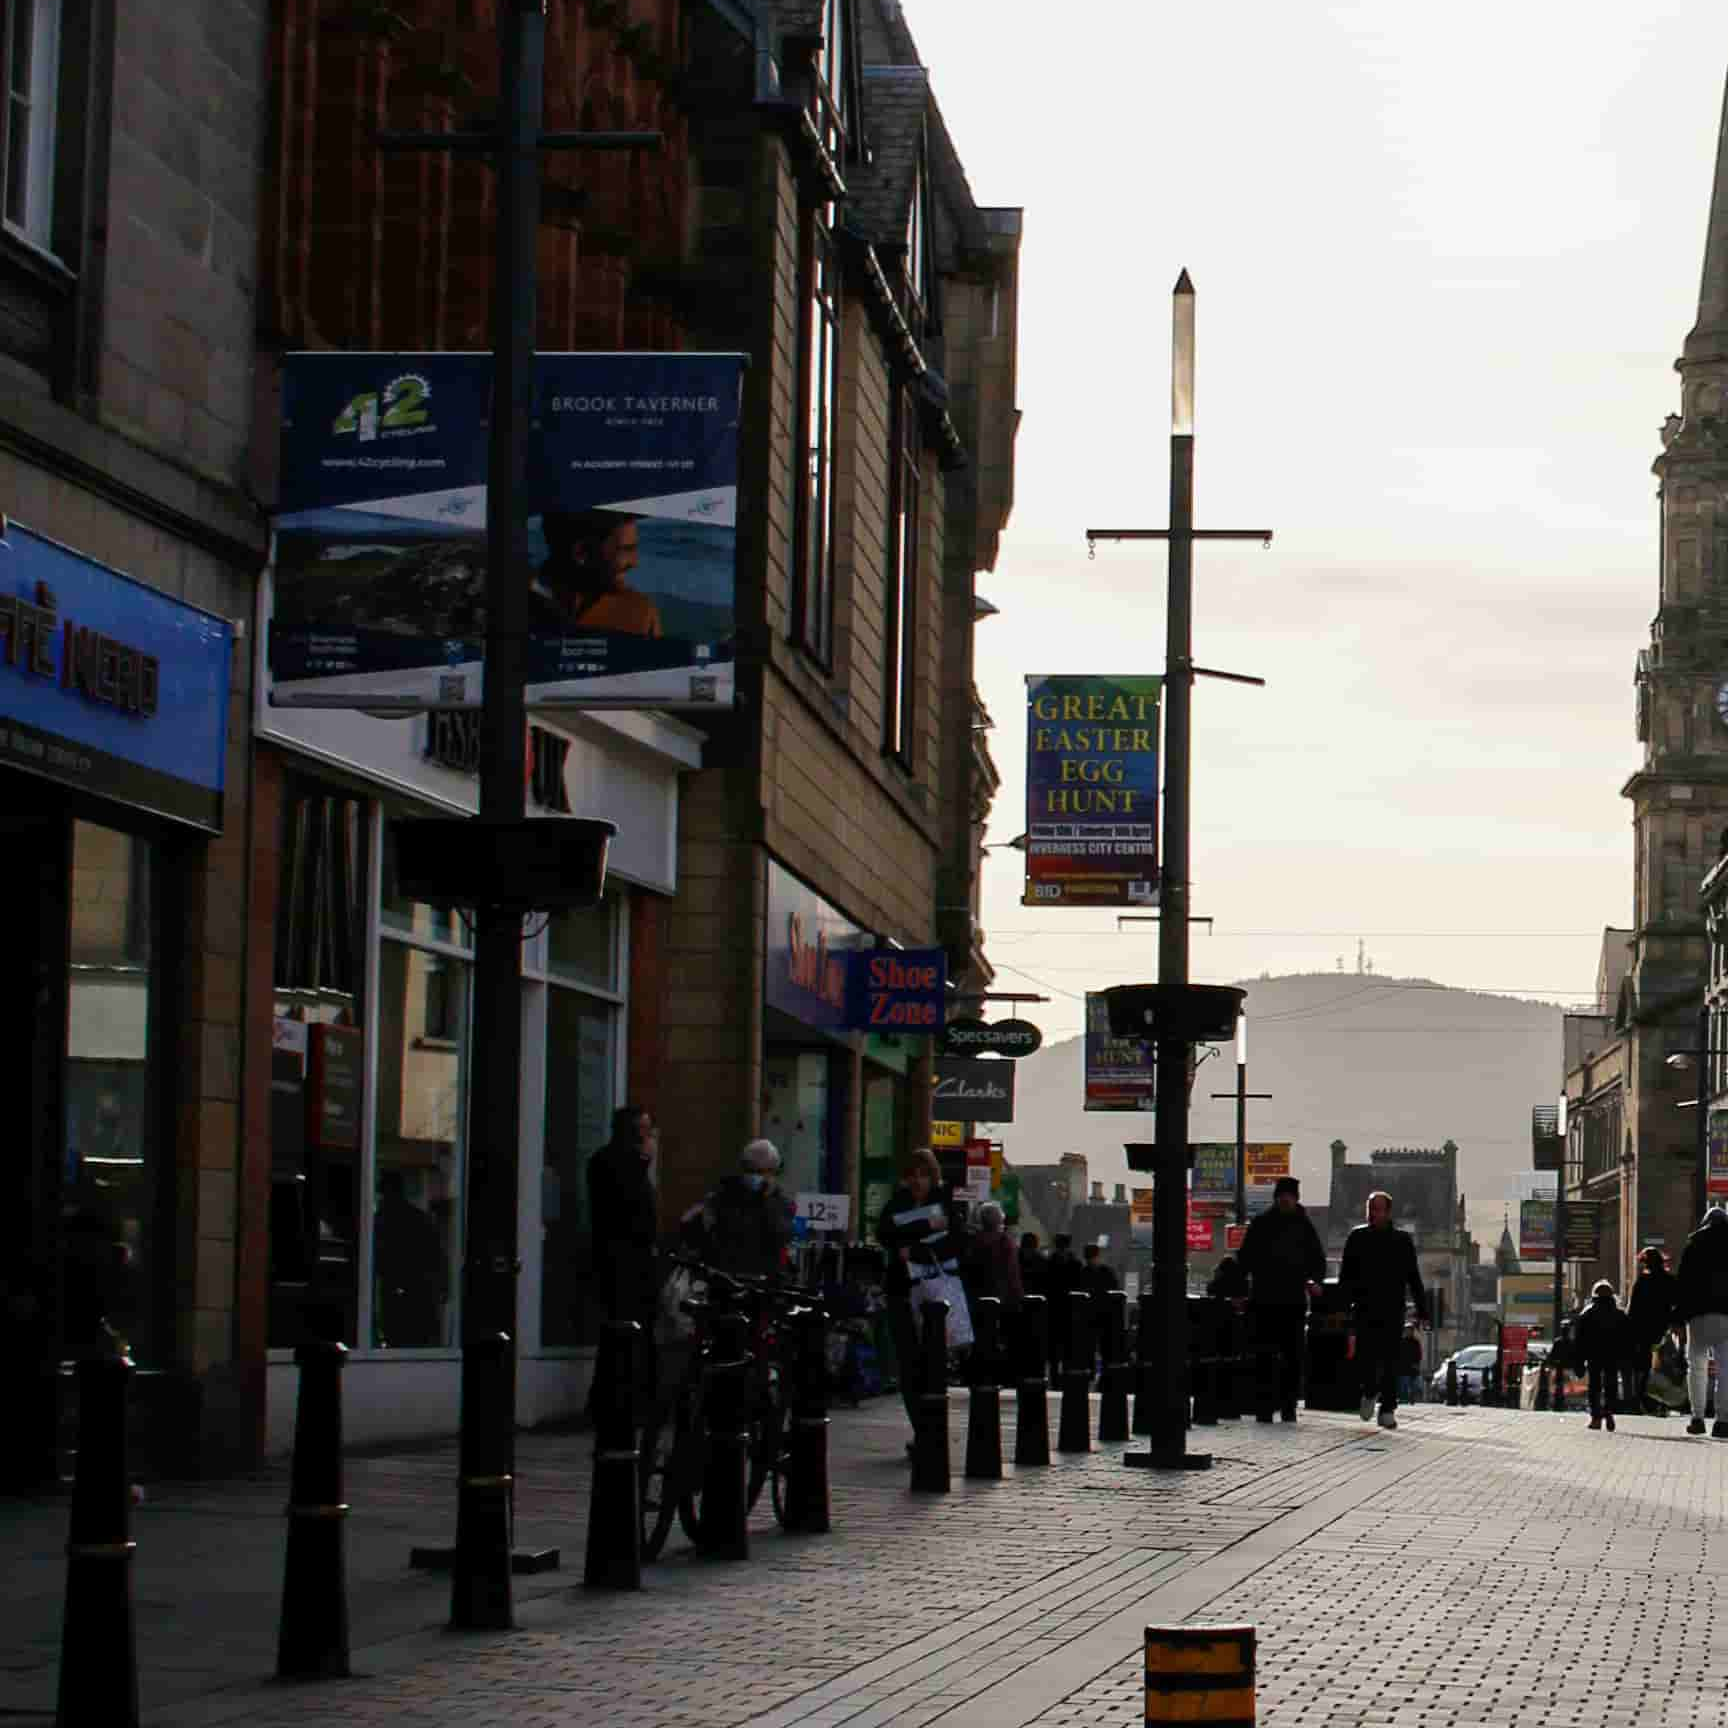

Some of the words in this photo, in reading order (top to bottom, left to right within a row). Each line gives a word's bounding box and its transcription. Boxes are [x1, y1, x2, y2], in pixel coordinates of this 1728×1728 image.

[551, 396, 617, 413] BROOK
[624, 396, 721, 413] TAVERNER
[1034, 694, 1151, 721] GREAT
[1036, 728, 1151, 753] EASTER
[1060, 759, 1124, 784] EGG
[1046, 788, 1136, 814] HUNT
[1087, 842, 1113, 855] CITY
[867, 957, 937, 990] Shoe
[870, 992, 937, 1024] Zone
[947, 1026, 1033, 1046] Specsavers
[935, 1076, 1009, 1100] Clarks
